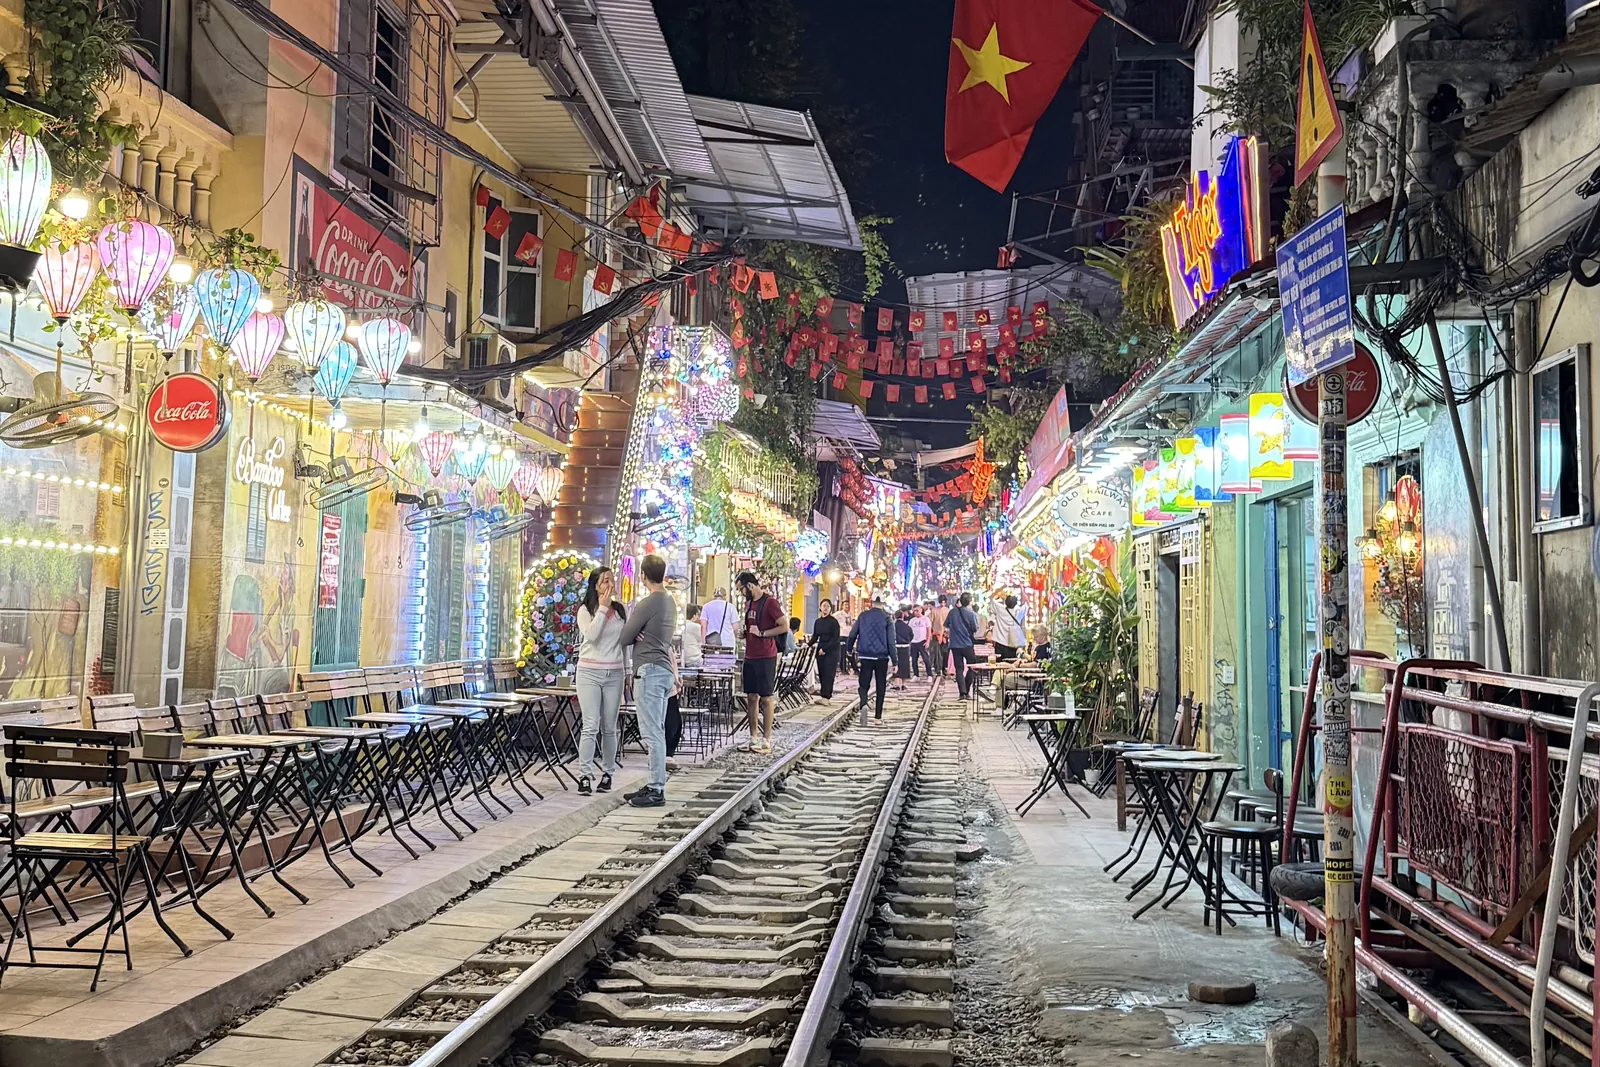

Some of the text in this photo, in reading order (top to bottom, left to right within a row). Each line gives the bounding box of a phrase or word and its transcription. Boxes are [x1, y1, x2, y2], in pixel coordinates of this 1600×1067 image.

[341, 225, 370, 255] DRINK
[1173, 169, 1222, 294] Tiger
[235, 436, 285, 488] Bamboo
[1061, 491, 1079, 508] OLD
